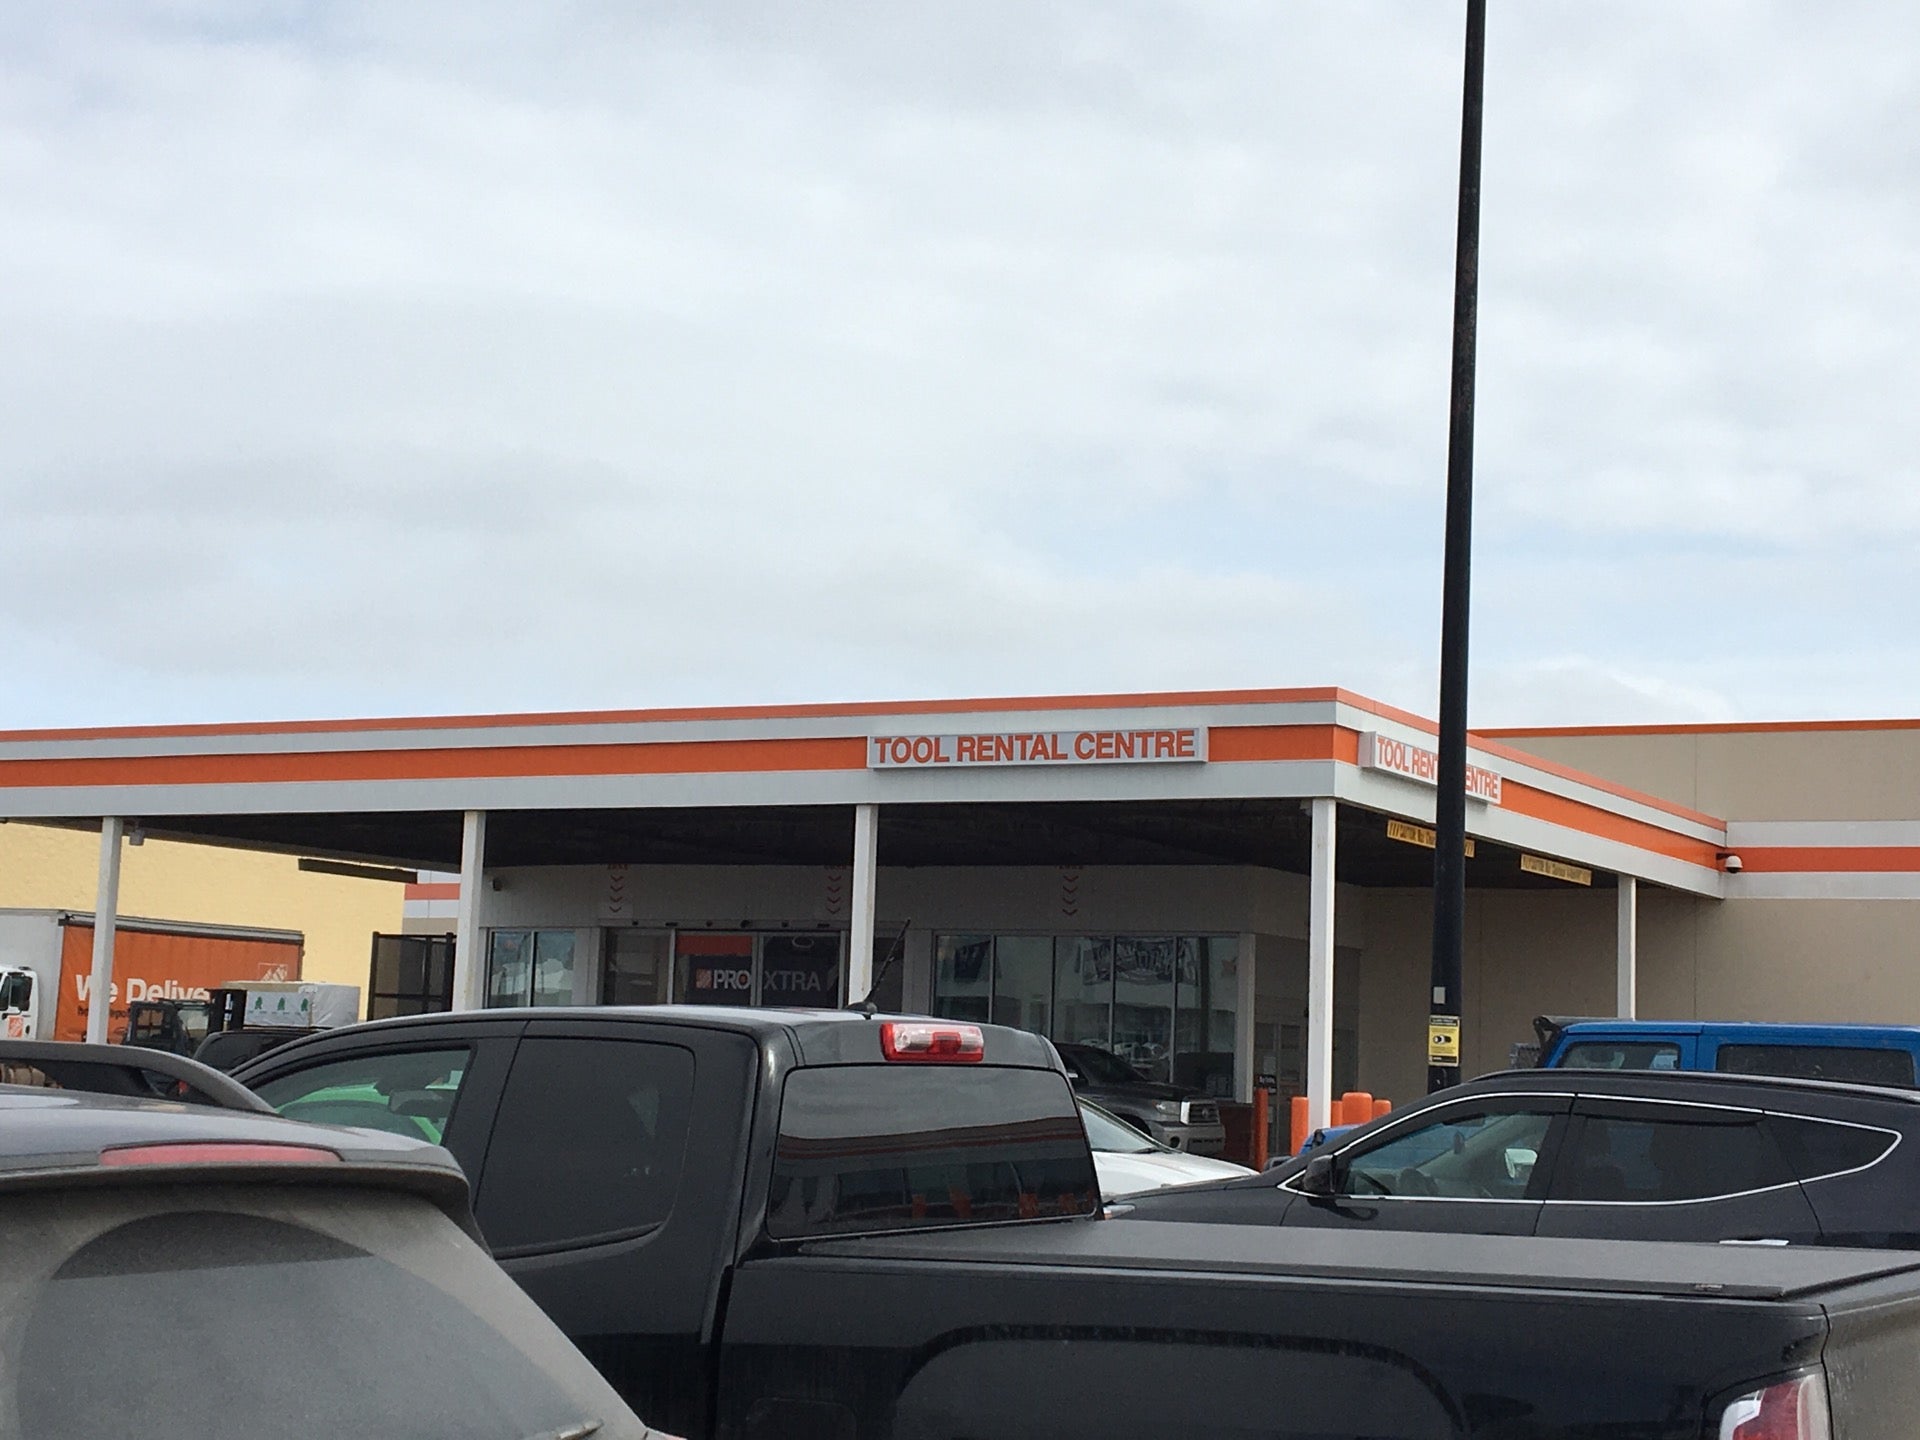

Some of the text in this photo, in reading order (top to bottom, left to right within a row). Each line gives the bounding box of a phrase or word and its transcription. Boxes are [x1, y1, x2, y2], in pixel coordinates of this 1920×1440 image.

[874, 729, 1196, 764] TOOL RENTAL CENTRE
[1377, 736, 1498, 799] TOOL REN ENTRE
[713, 969, 821, 992] PRO XTRA
